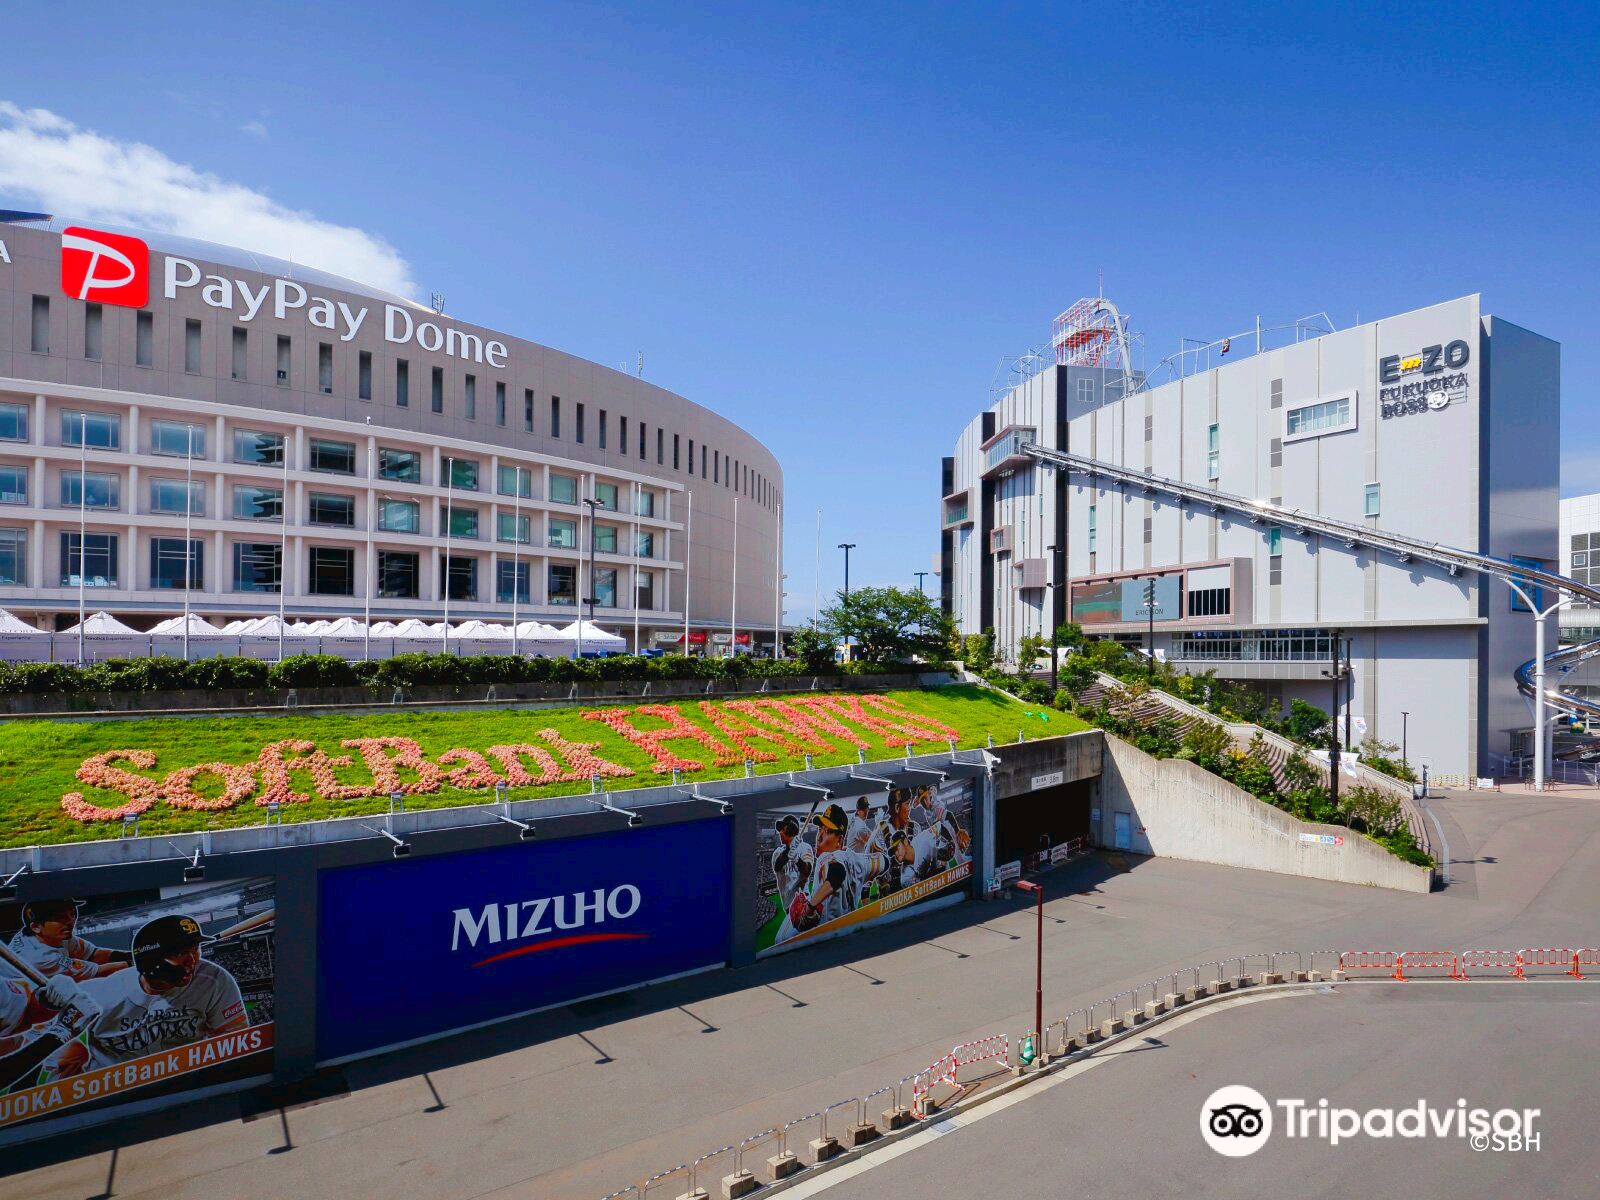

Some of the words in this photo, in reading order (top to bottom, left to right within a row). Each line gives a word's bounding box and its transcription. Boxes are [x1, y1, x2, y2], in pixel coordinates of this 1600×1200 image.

[164, 256, 368, 342] PayPay
[384, 304, 508, 368] Dome
[1379, 372, 1469, 402] FUKUOKA
[61, 728, 636, 822] SoftBank
[580, 694, 961, 775] HAWKS
[451, 884, 641, 951] MIZUHO
[880, 887, 913, 913] FUKUOKA
[914, 876, 946, 897] SoftBank
[946, 864, 970, 884] HAWKS
[72, 1056, 180, 1100] SoftBank
[188, 1029, 262, 1067] HAWKS
